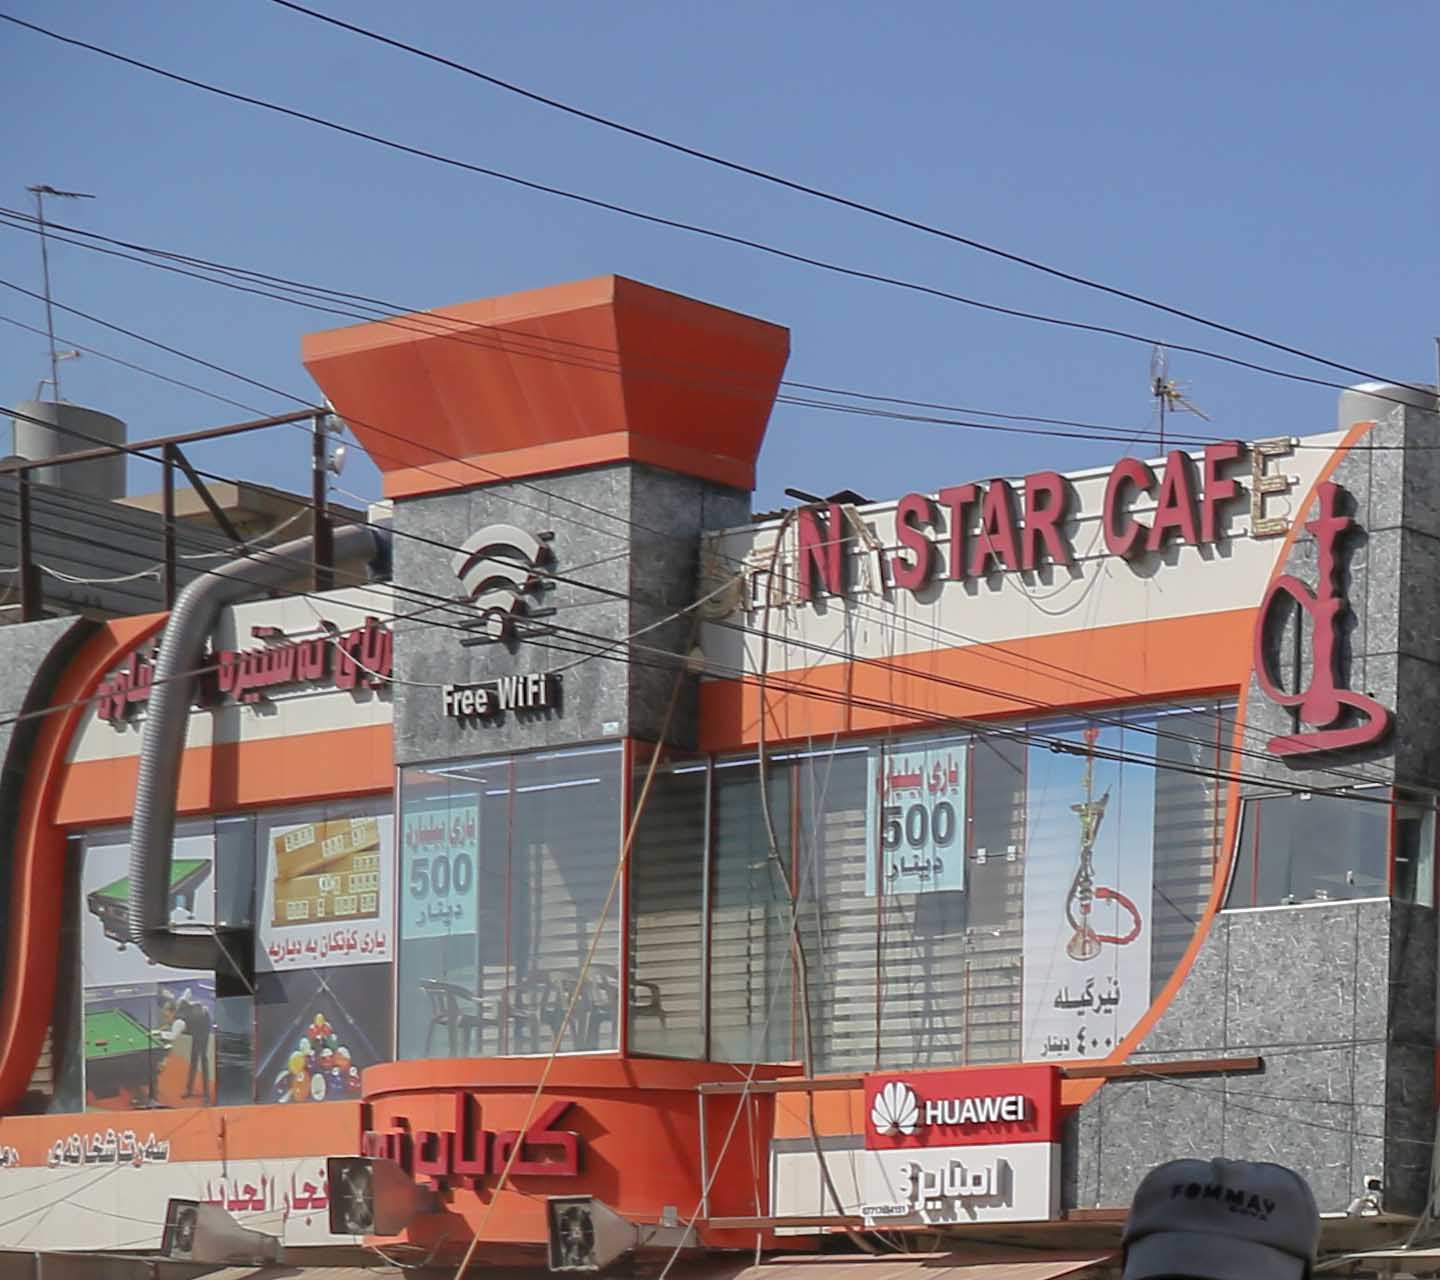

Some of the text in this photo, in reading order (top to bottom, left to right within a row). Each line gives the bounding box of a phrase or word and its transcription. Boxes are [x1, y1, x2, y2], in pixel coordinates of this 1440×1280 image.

[892, 471, 1070, 592] STAR
[1103, 437, 1294, 558] CAFE
[442, 672, 546, 717] Free WiFi
[883, 801, 956, 849] 500
[409, 852, 474, 900] 500
[925, 1095, 1025, 1126] HUAWEI
